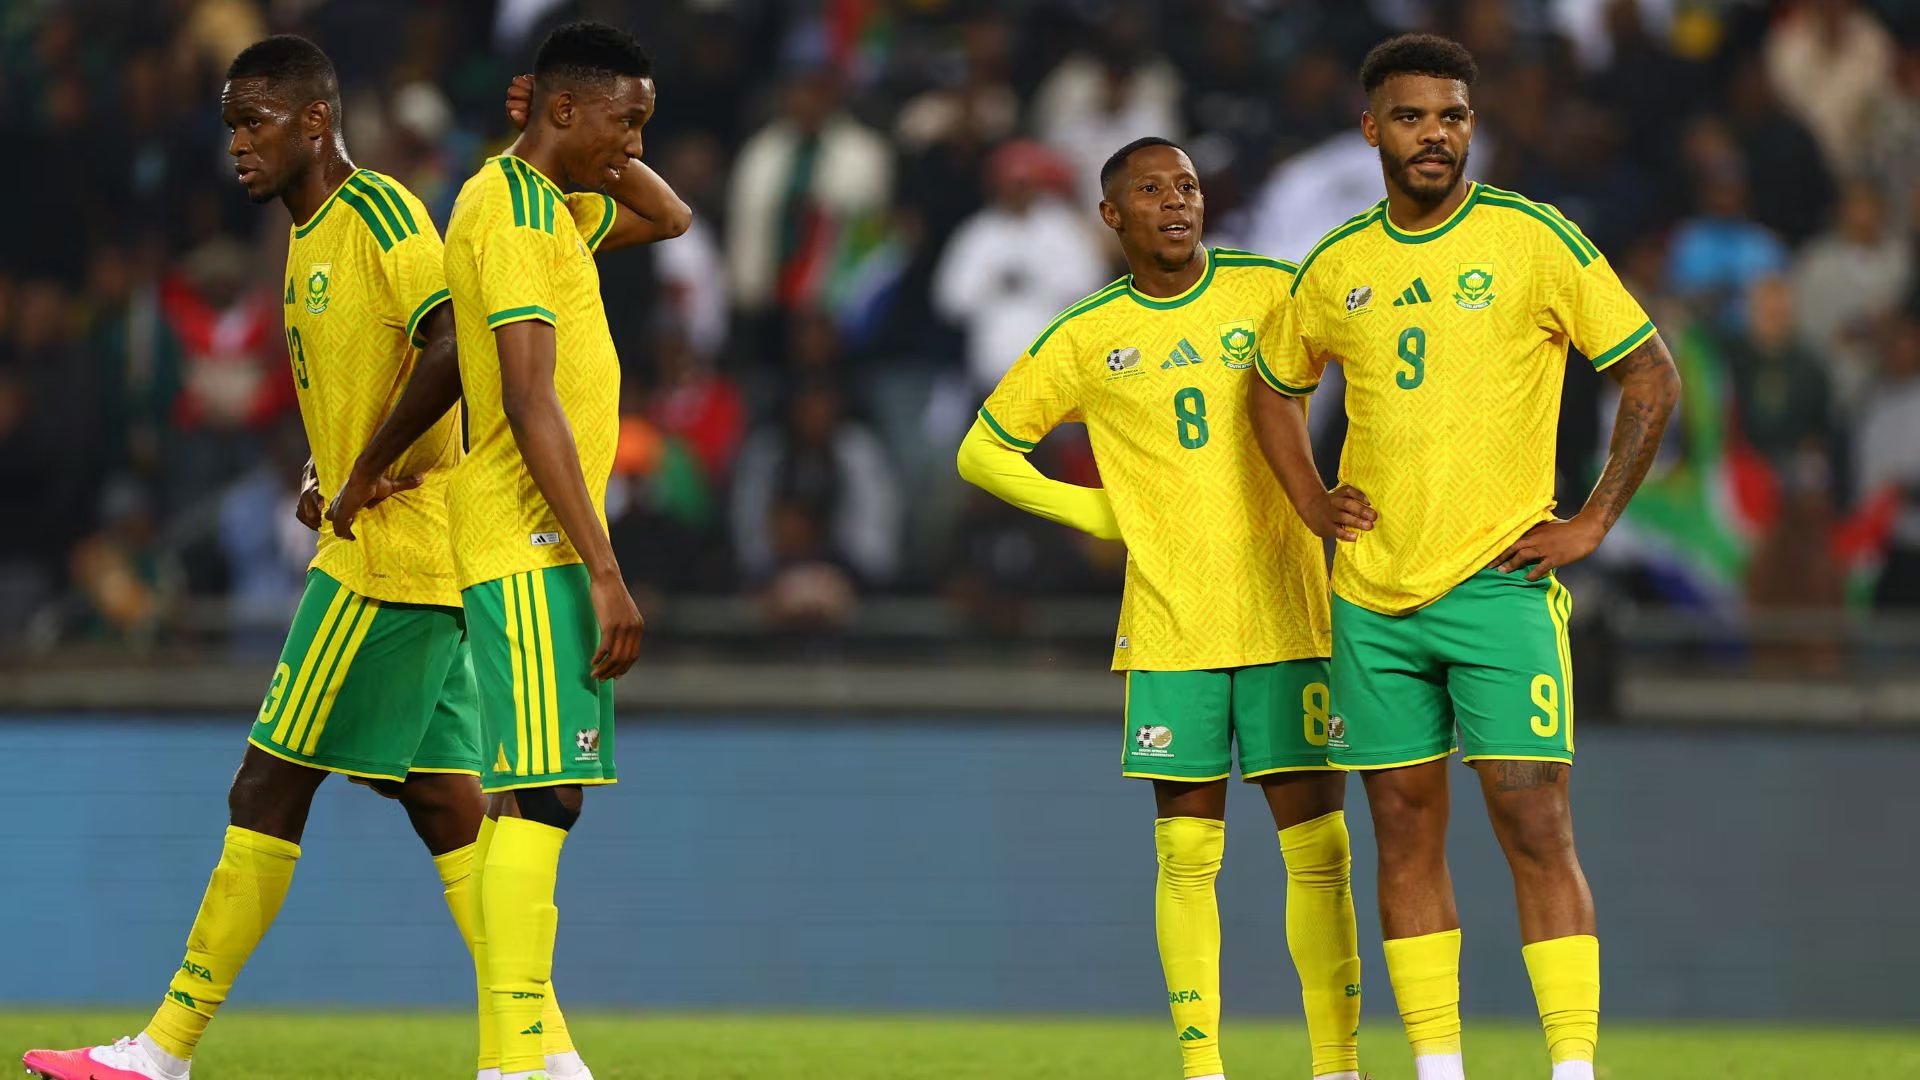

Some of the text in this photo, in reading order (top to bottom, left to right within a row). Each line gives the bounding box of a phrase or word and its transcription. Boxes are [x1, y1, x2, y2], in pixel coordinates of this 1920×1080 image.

[1396, 327, 1425, 389] 9
[1174, 387, 1209, 449] 8
[260, 662, 290, 723] 3
[1303, 682, 1329, 746] 8
[1530, 674, 1558, 737] 9
[182, 960, 212, 982] AFA
[1345, 984, 1361, 997] SA
